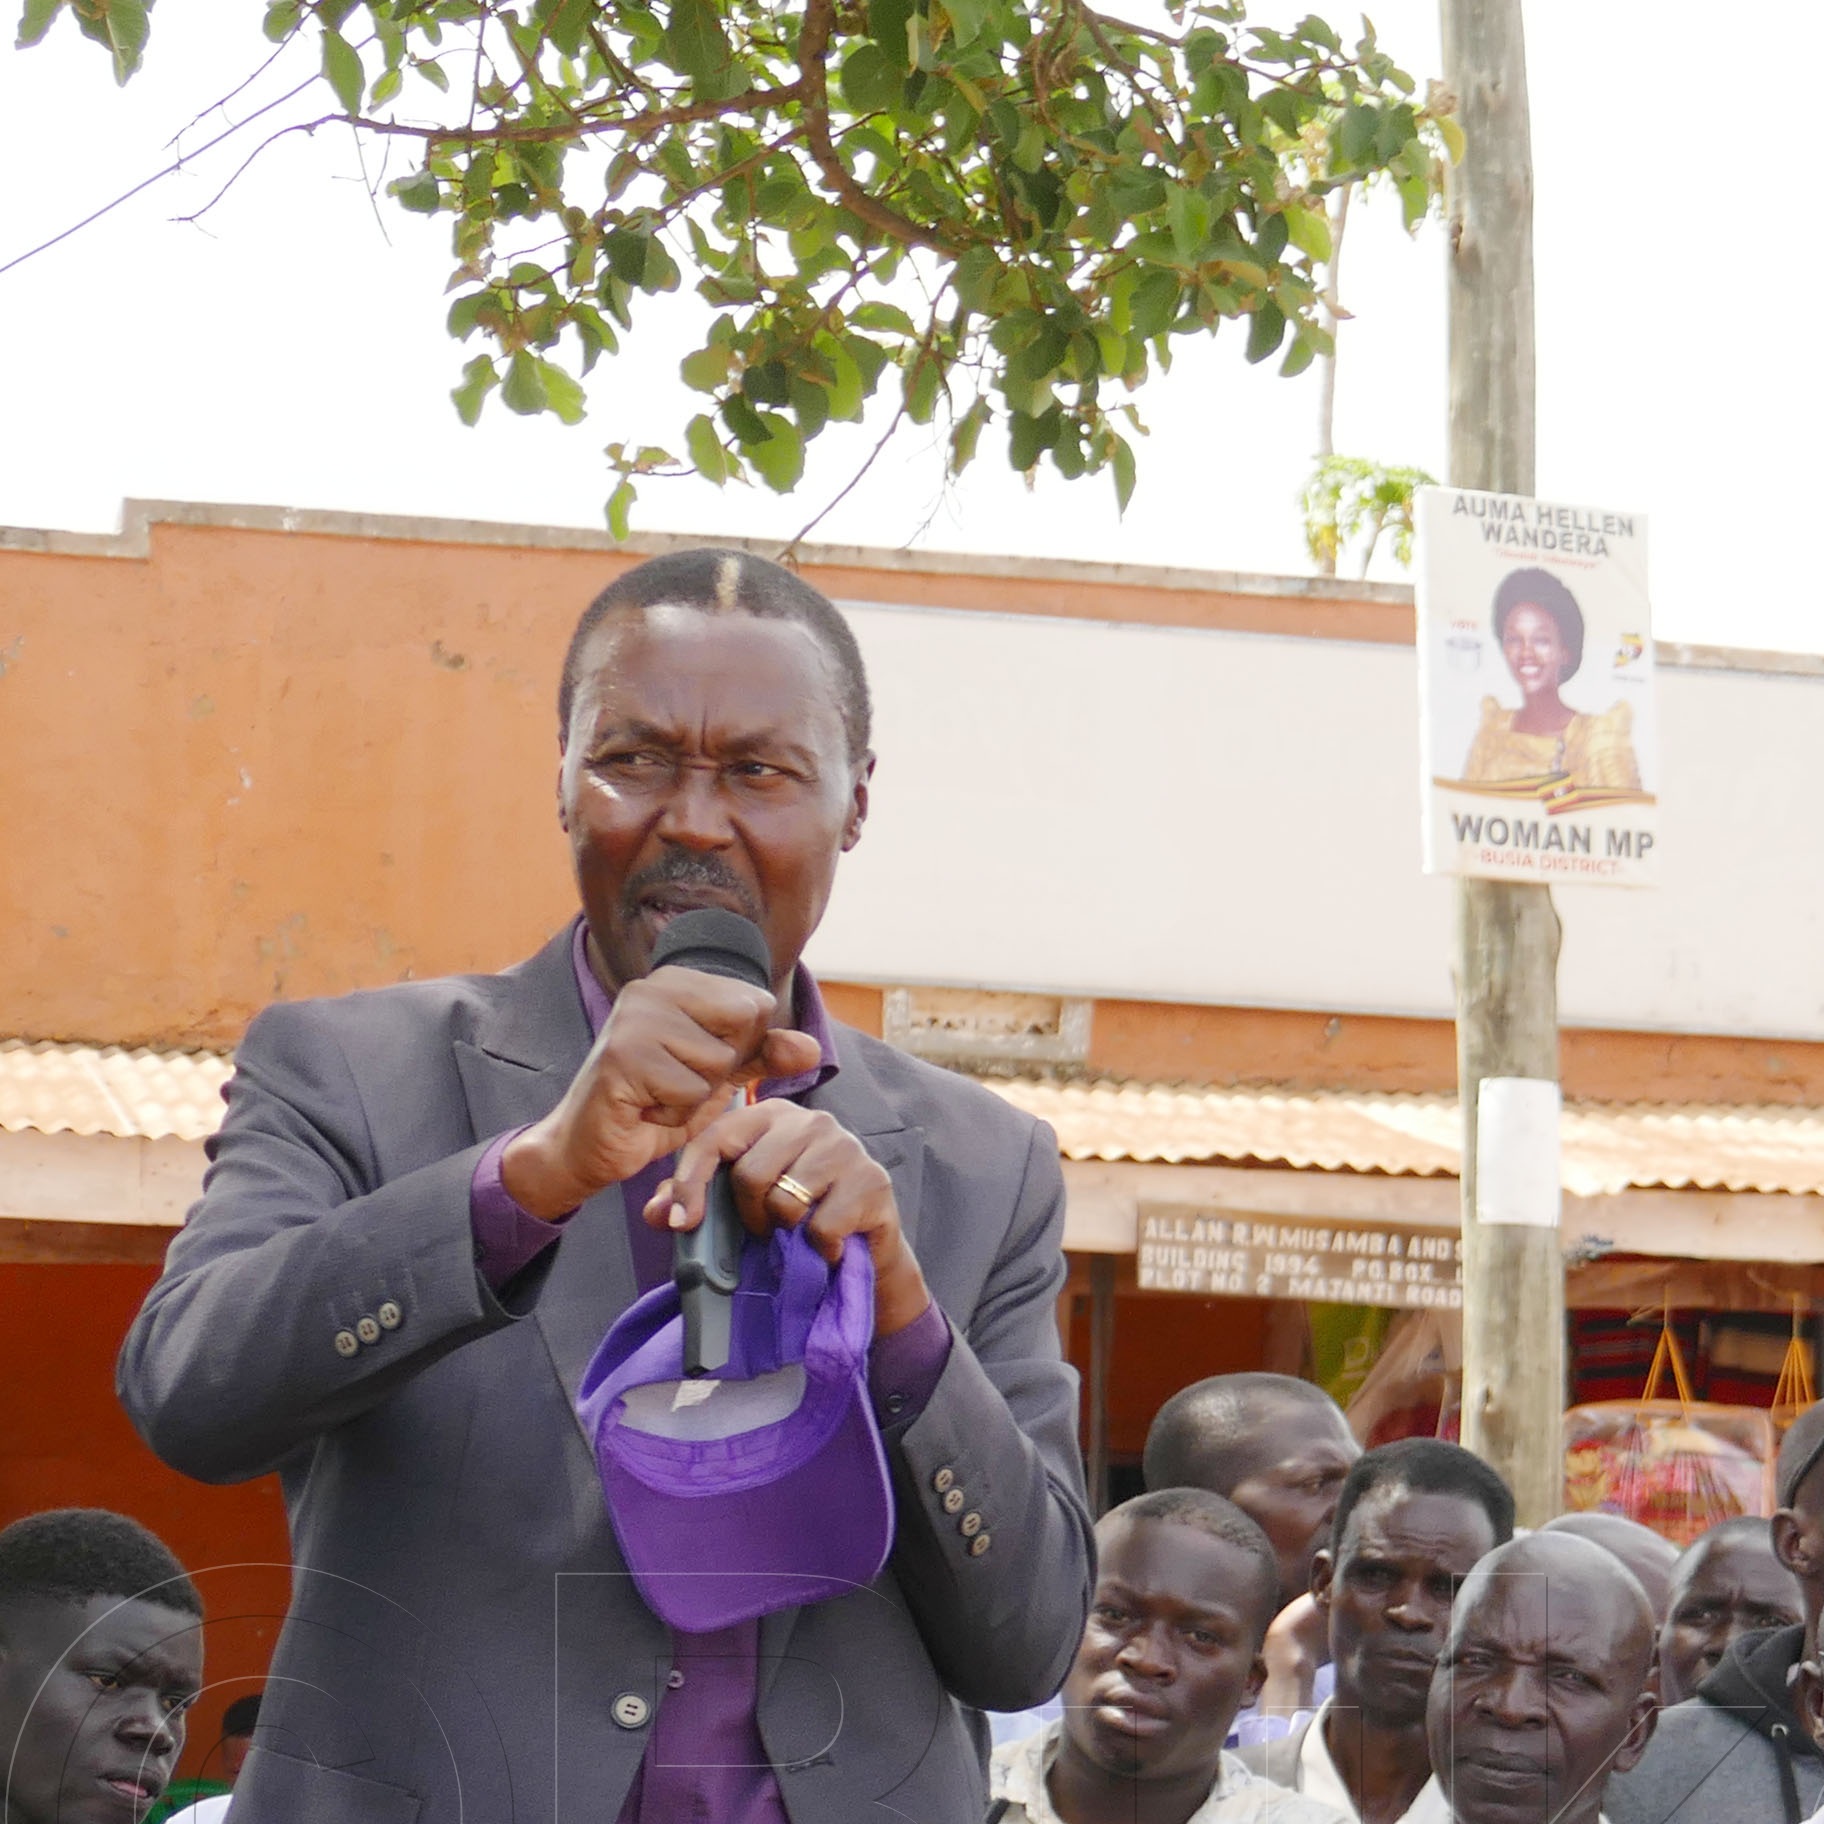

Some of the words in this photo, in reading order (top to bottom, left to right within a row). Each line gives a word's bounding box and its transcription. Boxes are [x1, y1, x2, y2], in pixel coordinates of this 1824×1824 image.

[1453, 495, 1526, 523] AUMA
[1536, 505, 1634, 537] HELLEN
[1481, 521, 1610, 557] WANDERA
[1452, 813, 1592, 854] WOMAN
[1606, 828, 1655, 859] MP
[1540, 854, 1618, 876] DISTRICT
[1145, 1216, 1224, 1243] ALLAN
